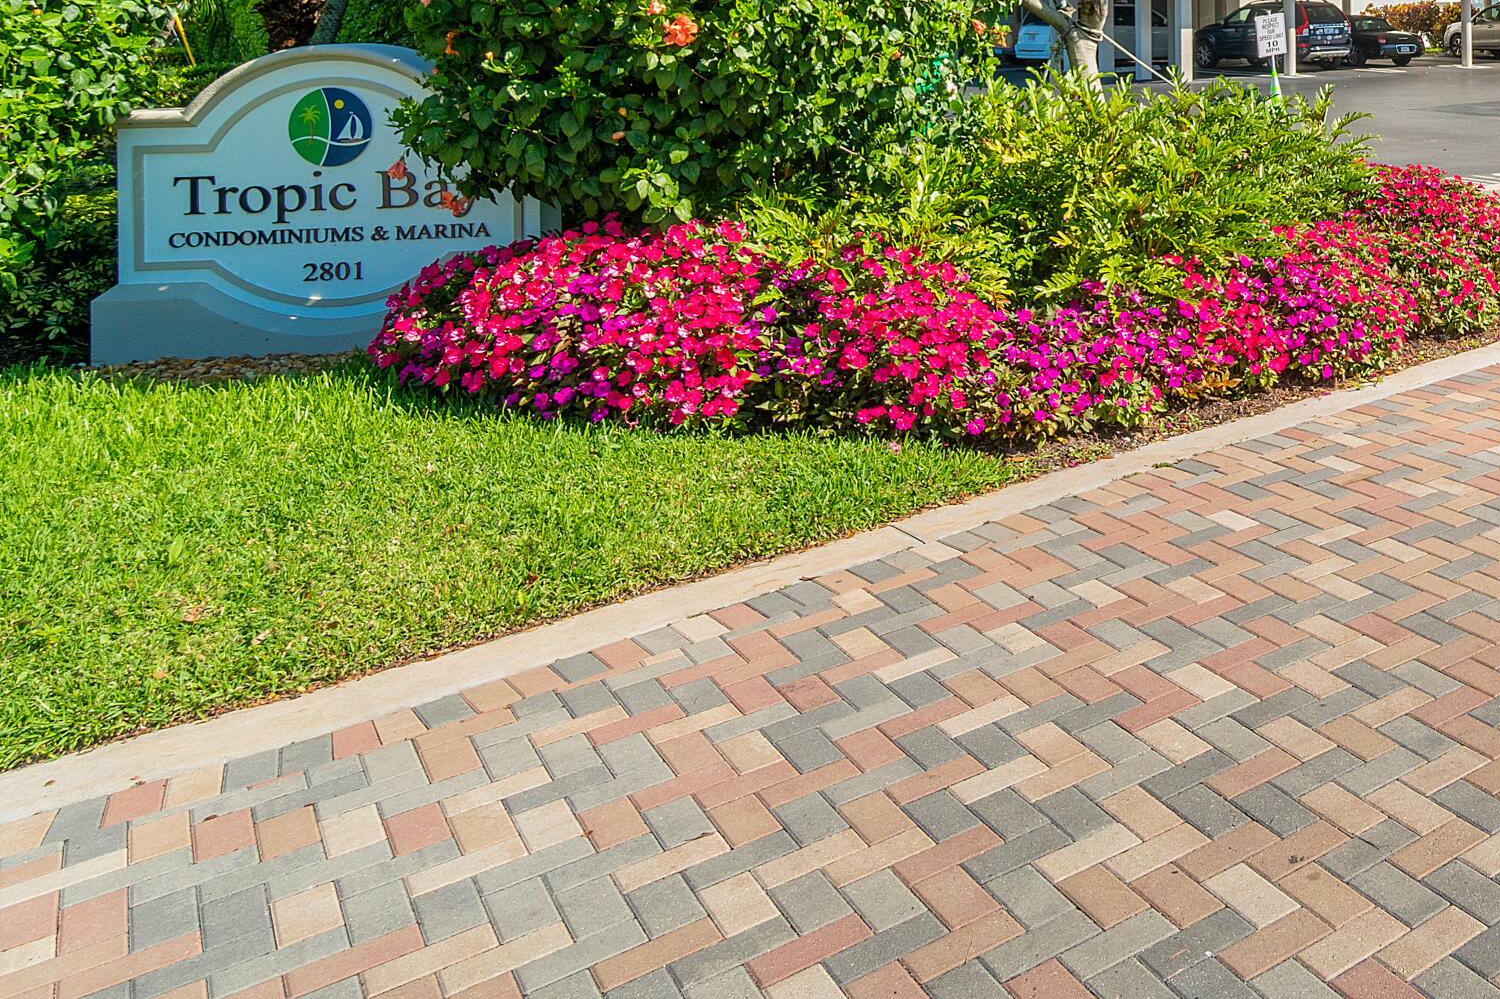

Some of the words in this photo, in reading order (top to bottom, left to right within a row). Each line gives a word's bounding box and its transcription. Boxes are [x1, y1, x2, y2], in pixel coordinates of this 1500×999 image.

[1262, 22, 1280, 30] RESPECT
[1259, 34, 1272, 42] SPEED
[1272, 32, 1284, 40] LIMIT
[1266, 40, 1279, 48] 10
[173, 170, 358, 224] Tropic
[168, 226, 364, 249] CONDOMINIUMS
[370, 225, 390, 242] &
[395, 222, 492, 241] MARINA
[302, 261, 364, 283] 2801
